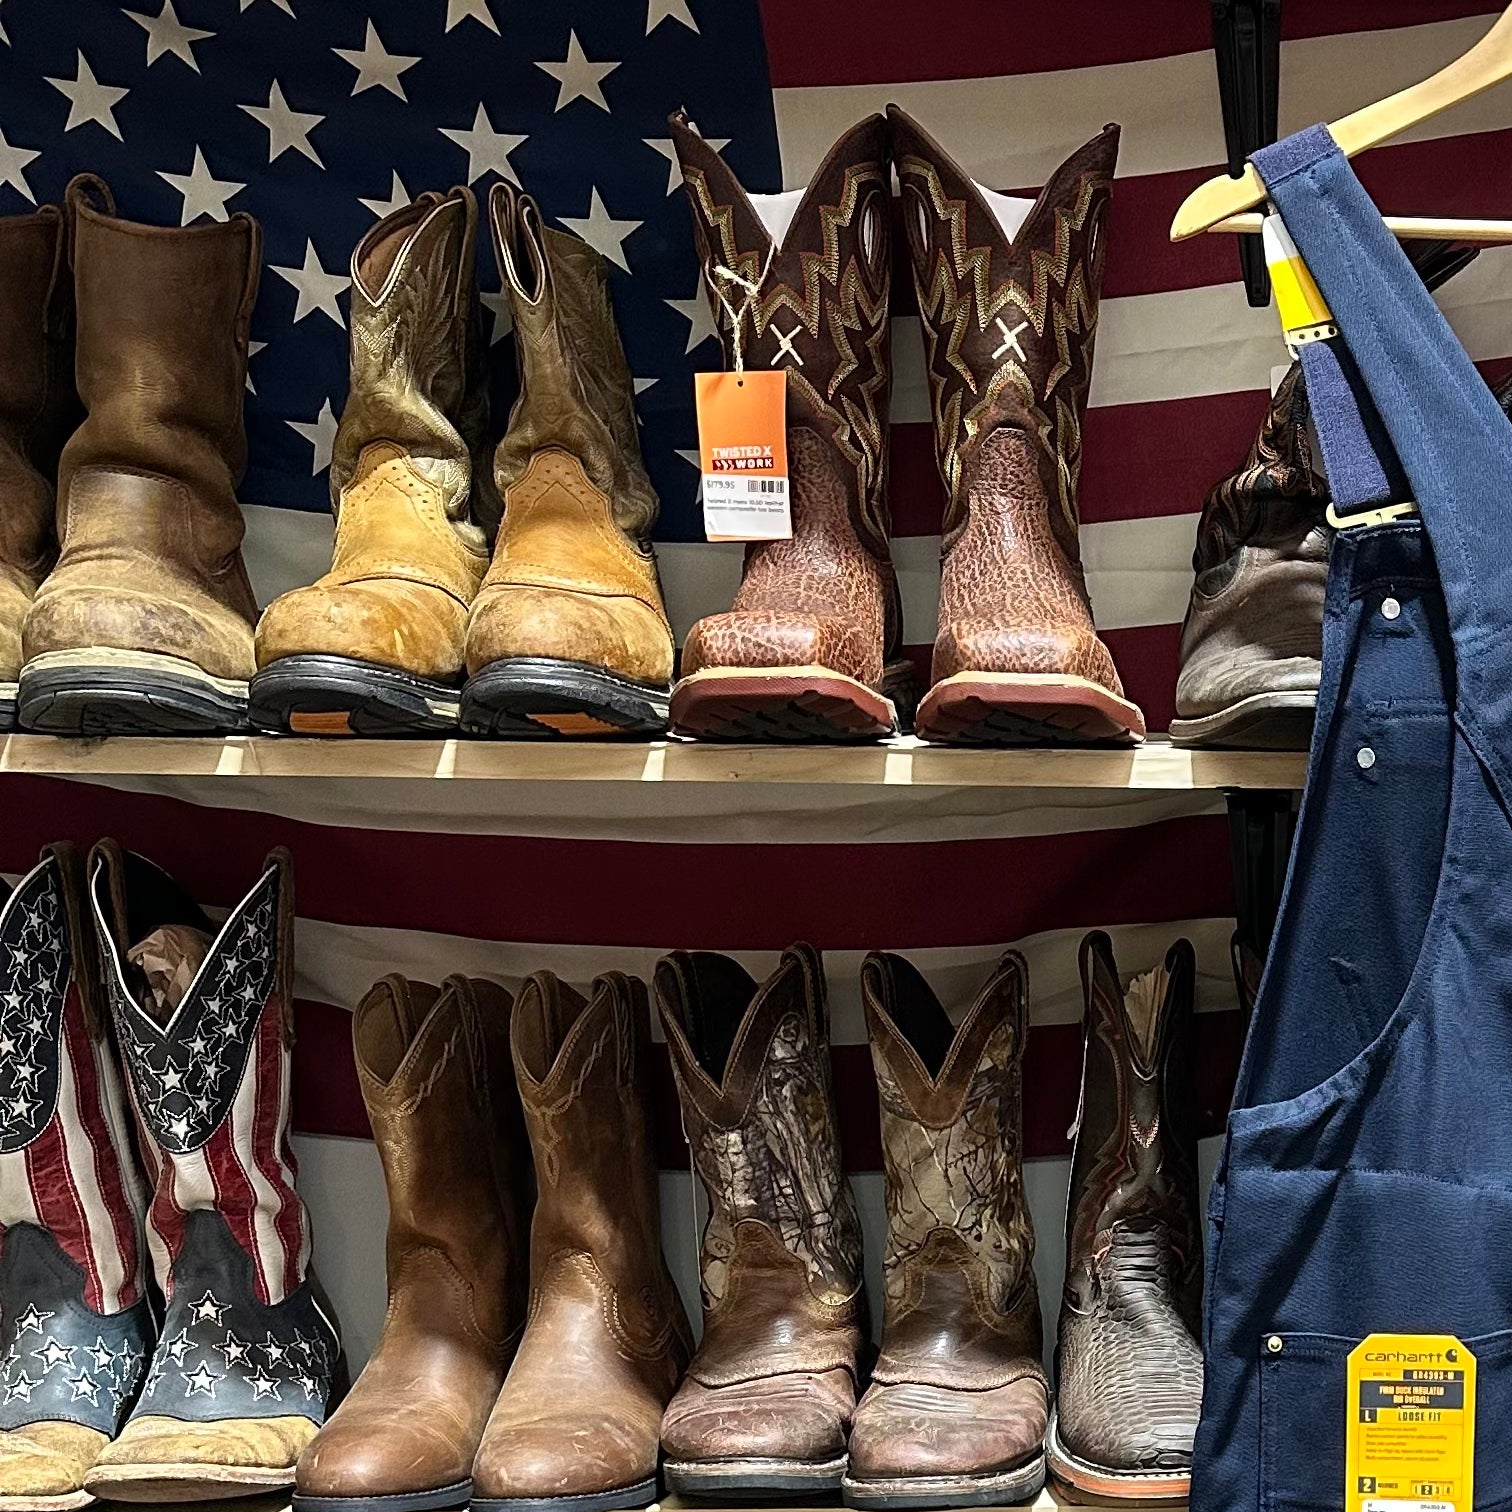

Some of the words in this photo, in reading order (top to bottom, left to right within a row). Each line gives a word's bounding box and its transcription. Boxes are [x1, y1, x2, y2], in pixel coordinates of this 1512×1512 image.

[712, 445, 761, 459] TWISTED
[763, 445, 772, 457] X
[735, 458, 773, 469] WORK
[1365, 1351, 1442, 1363] carhartt
[1364, 1409, 1371, 1421] L
[1398, 1412, 1424, 1422] LOOSE
[1428, 1412, 1441, 1422] FIT
[1363, 1478, 1371, 1492] 2
[1424, 1485, 1430, 1494] 2
